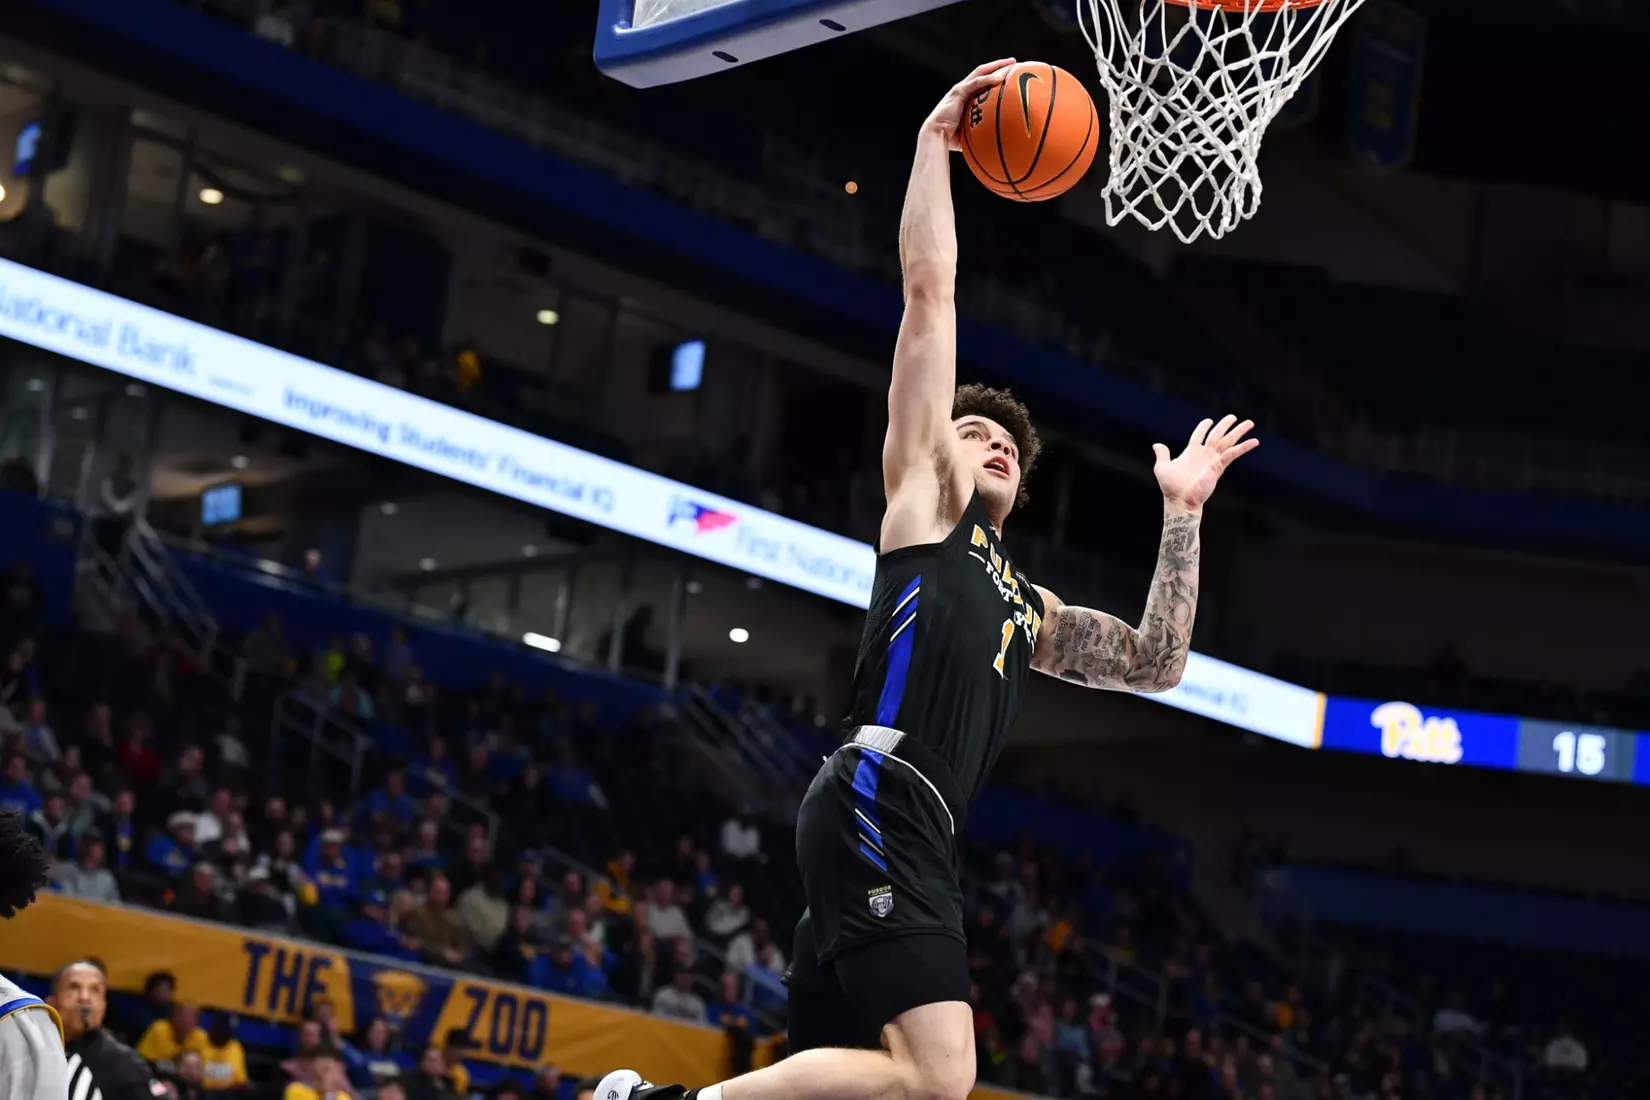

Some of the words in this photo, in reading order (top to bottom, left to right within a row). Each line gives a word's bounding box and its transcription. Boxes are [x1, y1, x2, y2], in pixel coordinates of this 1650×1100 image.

[0, 285, 112, 347] ational
[117, 322, 196, 376] Bank
[283, 386, 391, 444] Improving
[498, 455, 584, 500] Financial
[592, 484, 616, 514] IQ
[788, 543, 875, 592] Nationa
[993, 618, 1015, 680] 1
[1370, 701, 1463, 764] Pitt
[1552, 731, 1606, 775] 15
[243, 940, 332, 1014] THE
[463, 985, 548, 1061] ZOO
